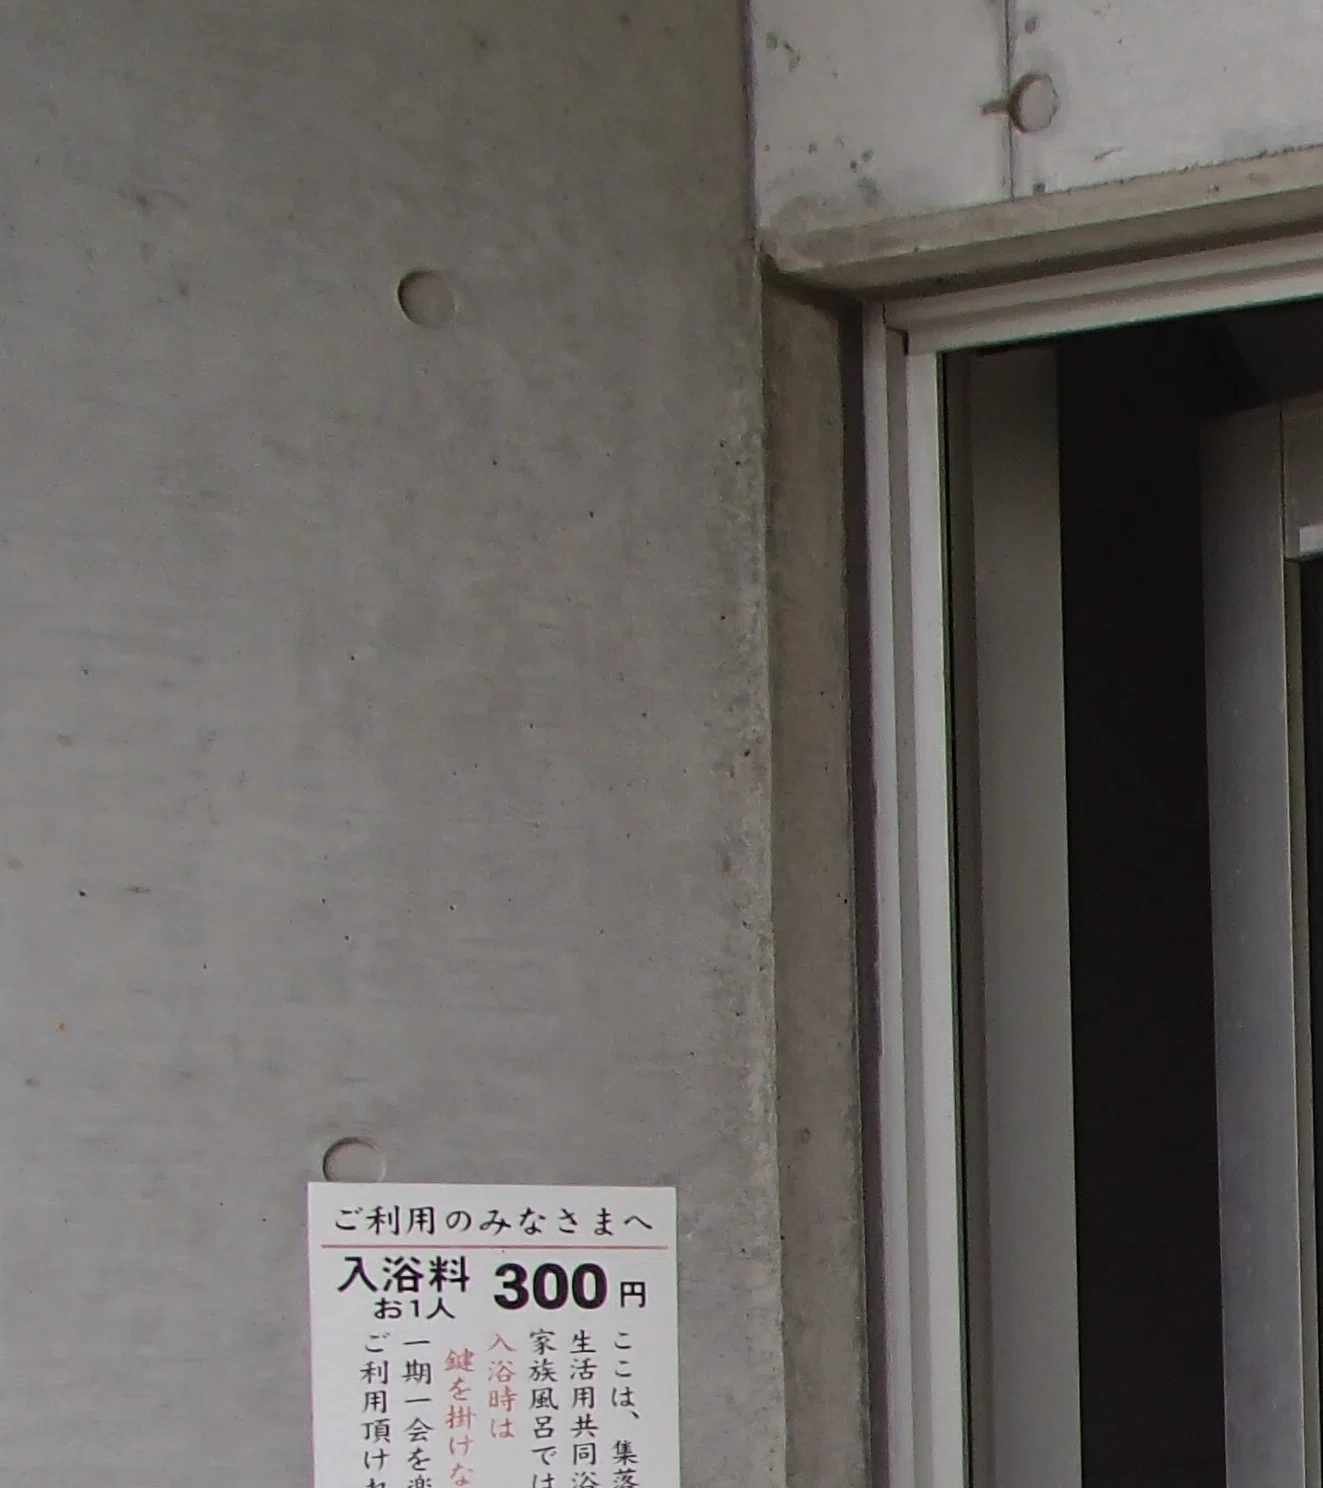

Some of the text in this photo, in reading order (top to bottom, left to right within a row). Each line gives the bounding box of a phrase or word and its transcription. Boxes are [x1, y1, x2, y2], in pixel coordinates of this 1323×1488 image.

[334, 1205, 653, 1236] ご利用のみなさまへ
[337, 1255, 470, 1293] 入浴料
[374, 1298, 456, 1319] お1人
[487, 1332, 518, 1438] 入浴時は
